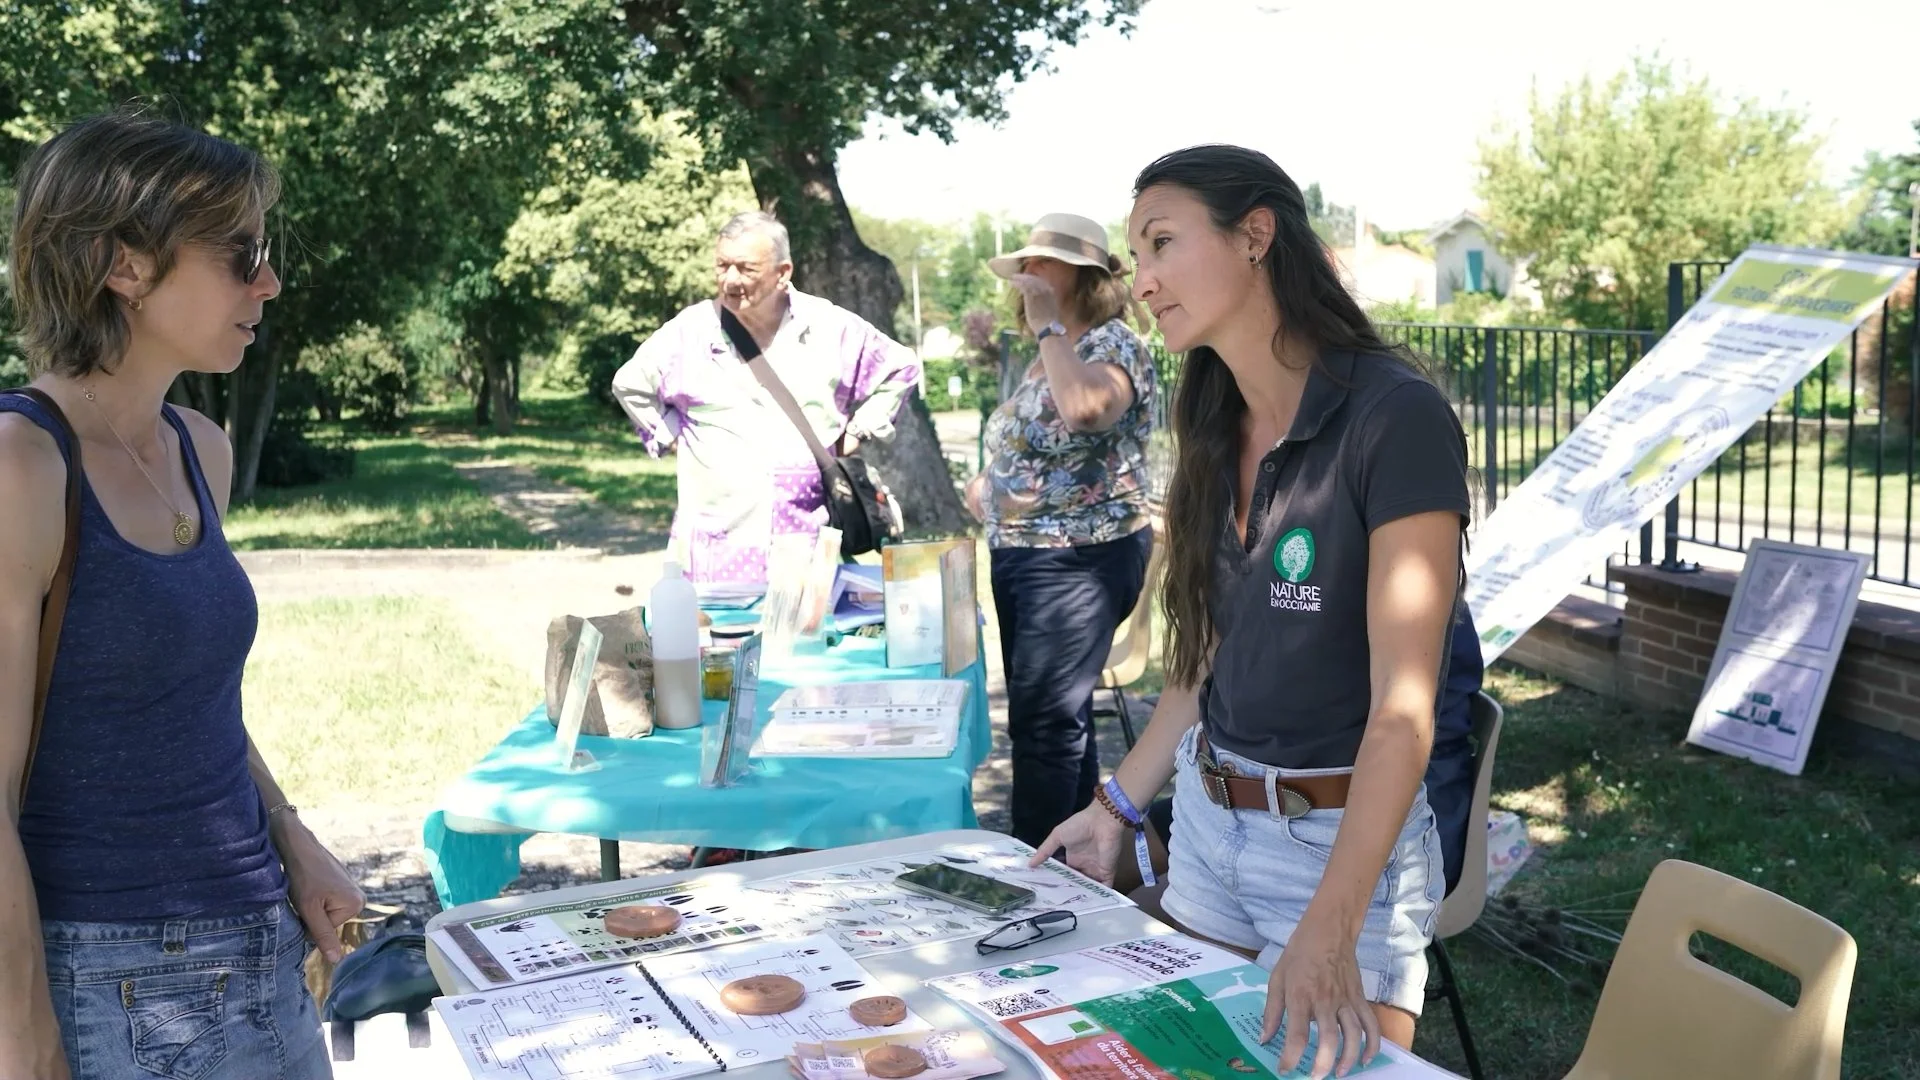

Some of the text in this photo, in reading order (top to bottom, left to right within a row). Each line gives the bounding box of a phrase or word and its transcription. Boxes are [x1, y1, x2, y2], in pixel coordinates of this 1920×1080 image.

[1270, 582, 1321, 602] NATURE
[1271, 598, 1321, 612] EN OCCITANIE
[1074, 878, 1114, 898] JARDINS
[1099, 946, 1175, 975] Communale
[1167, 947, 1189, 955] de
[1184, 952, 1203, 961] la
[1108, 1040, 1132, 1058] Aider
[1097, 1041, 1109, 1053] du
[1105, 1051, 1140, 1080] territoire
